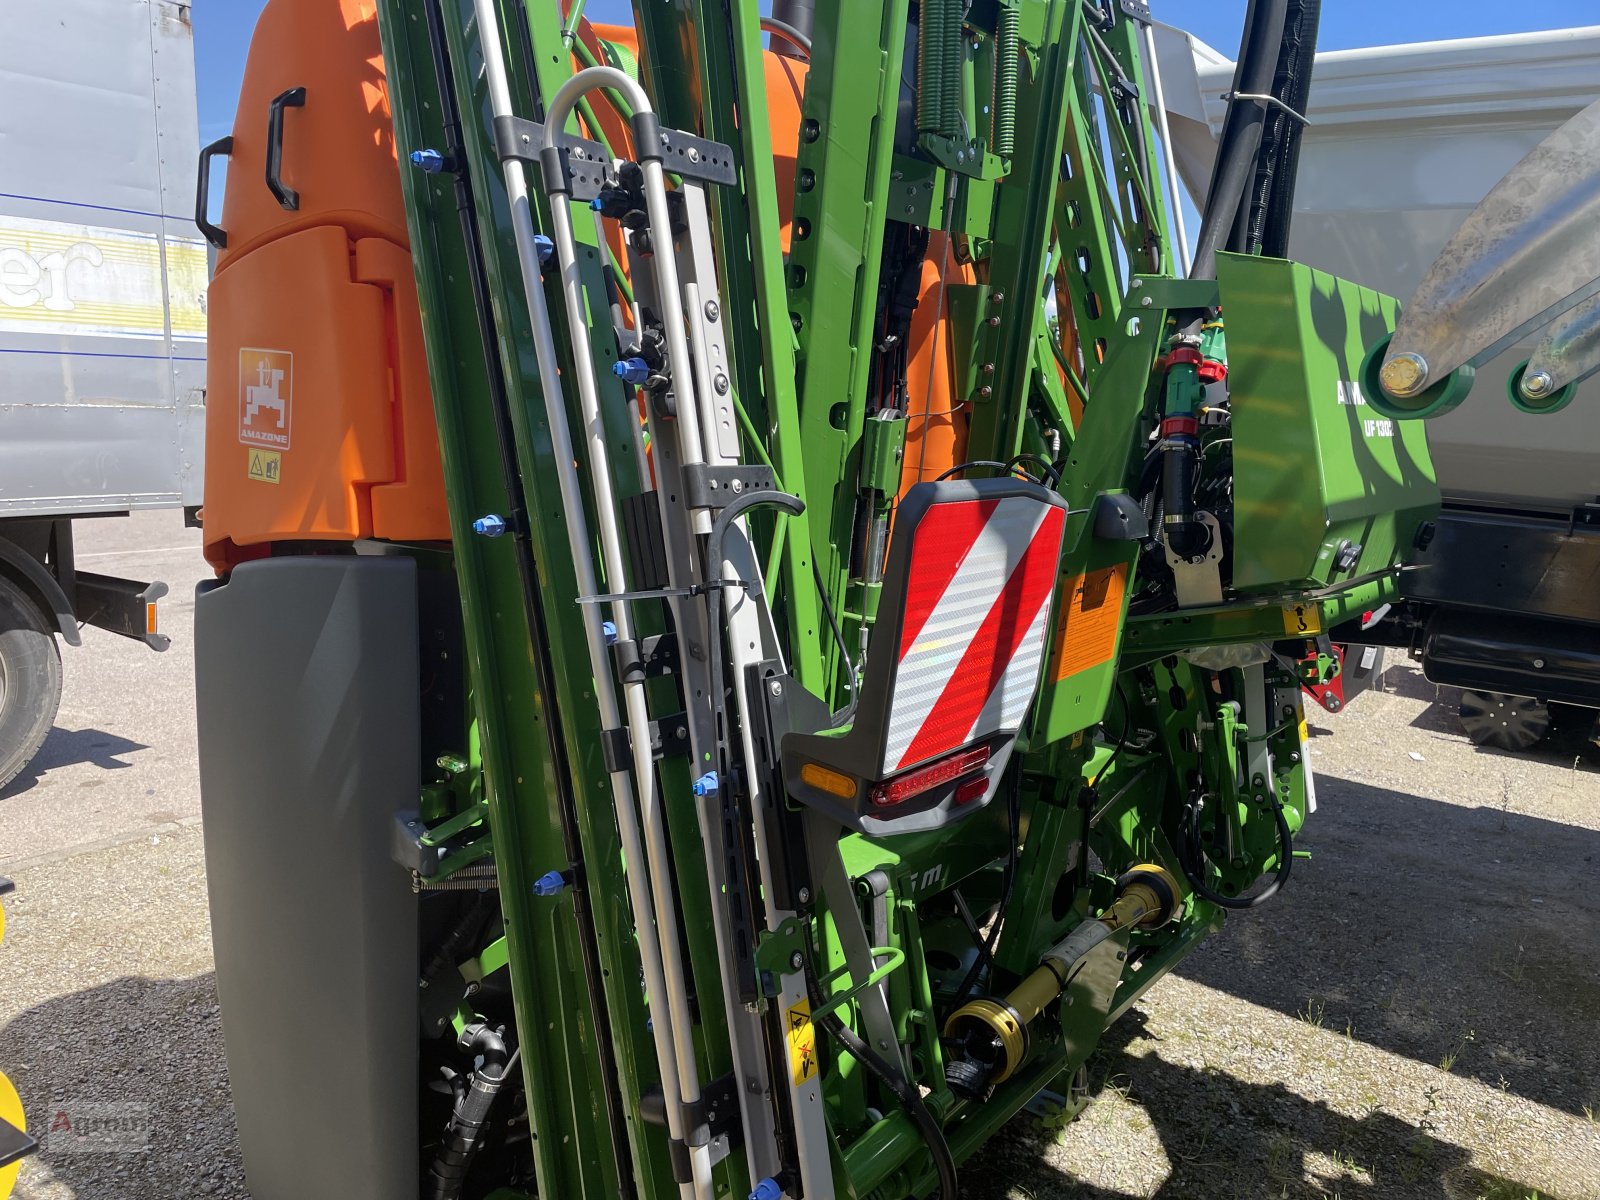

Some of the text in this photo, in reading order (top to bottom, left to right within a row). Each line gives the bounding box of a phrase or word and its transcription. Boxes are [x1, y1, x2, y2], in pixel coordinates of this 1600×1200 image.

[241, 429, 288, 444] AMAZONE
[1364, 419, 1394, 437] UF 1302
[920, 863, 943, 890] m
